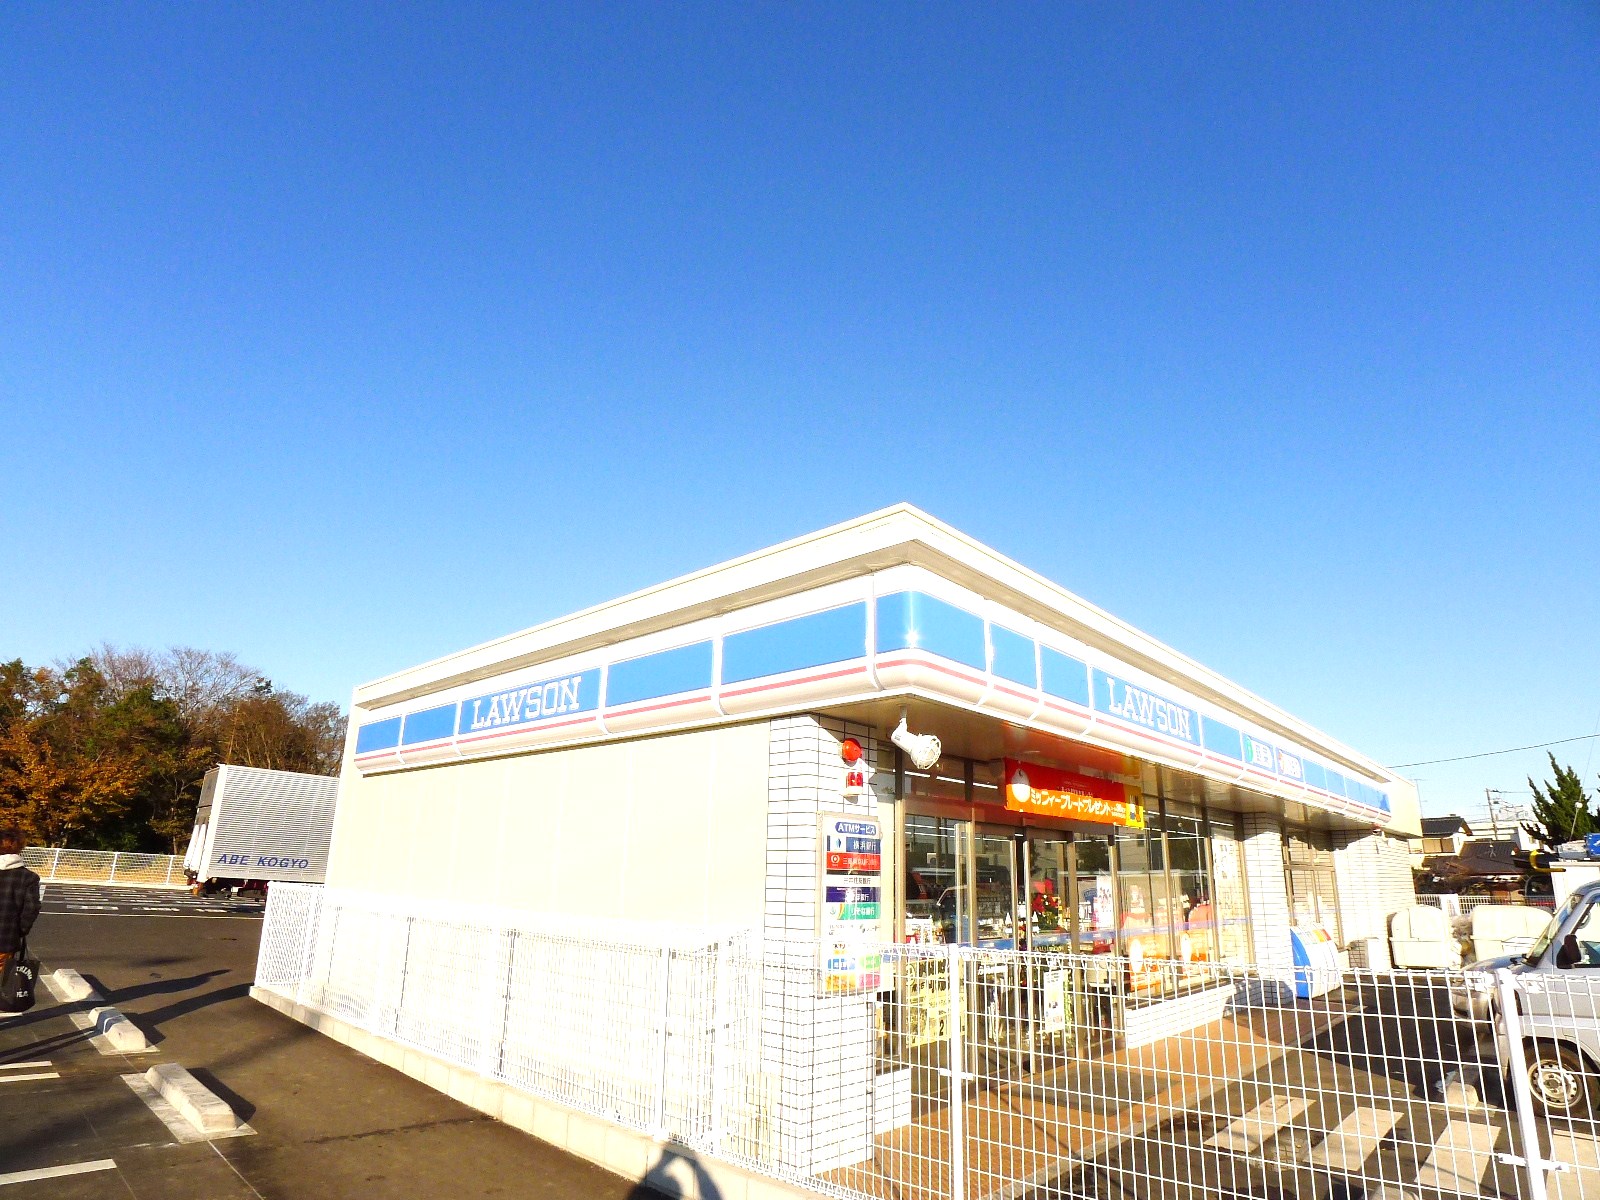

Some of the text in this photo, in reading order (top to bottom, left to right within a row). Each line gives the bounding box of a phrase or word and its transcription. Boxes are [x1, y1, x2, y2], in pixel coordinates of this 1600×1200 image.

[471, 675, 582, 730] LAWSON
[1106, 677, 1192, 741] LAWSON
[837, 822, 875, 834] ATMサービス
[217, 853, 309, 869] ABE KOGYO
